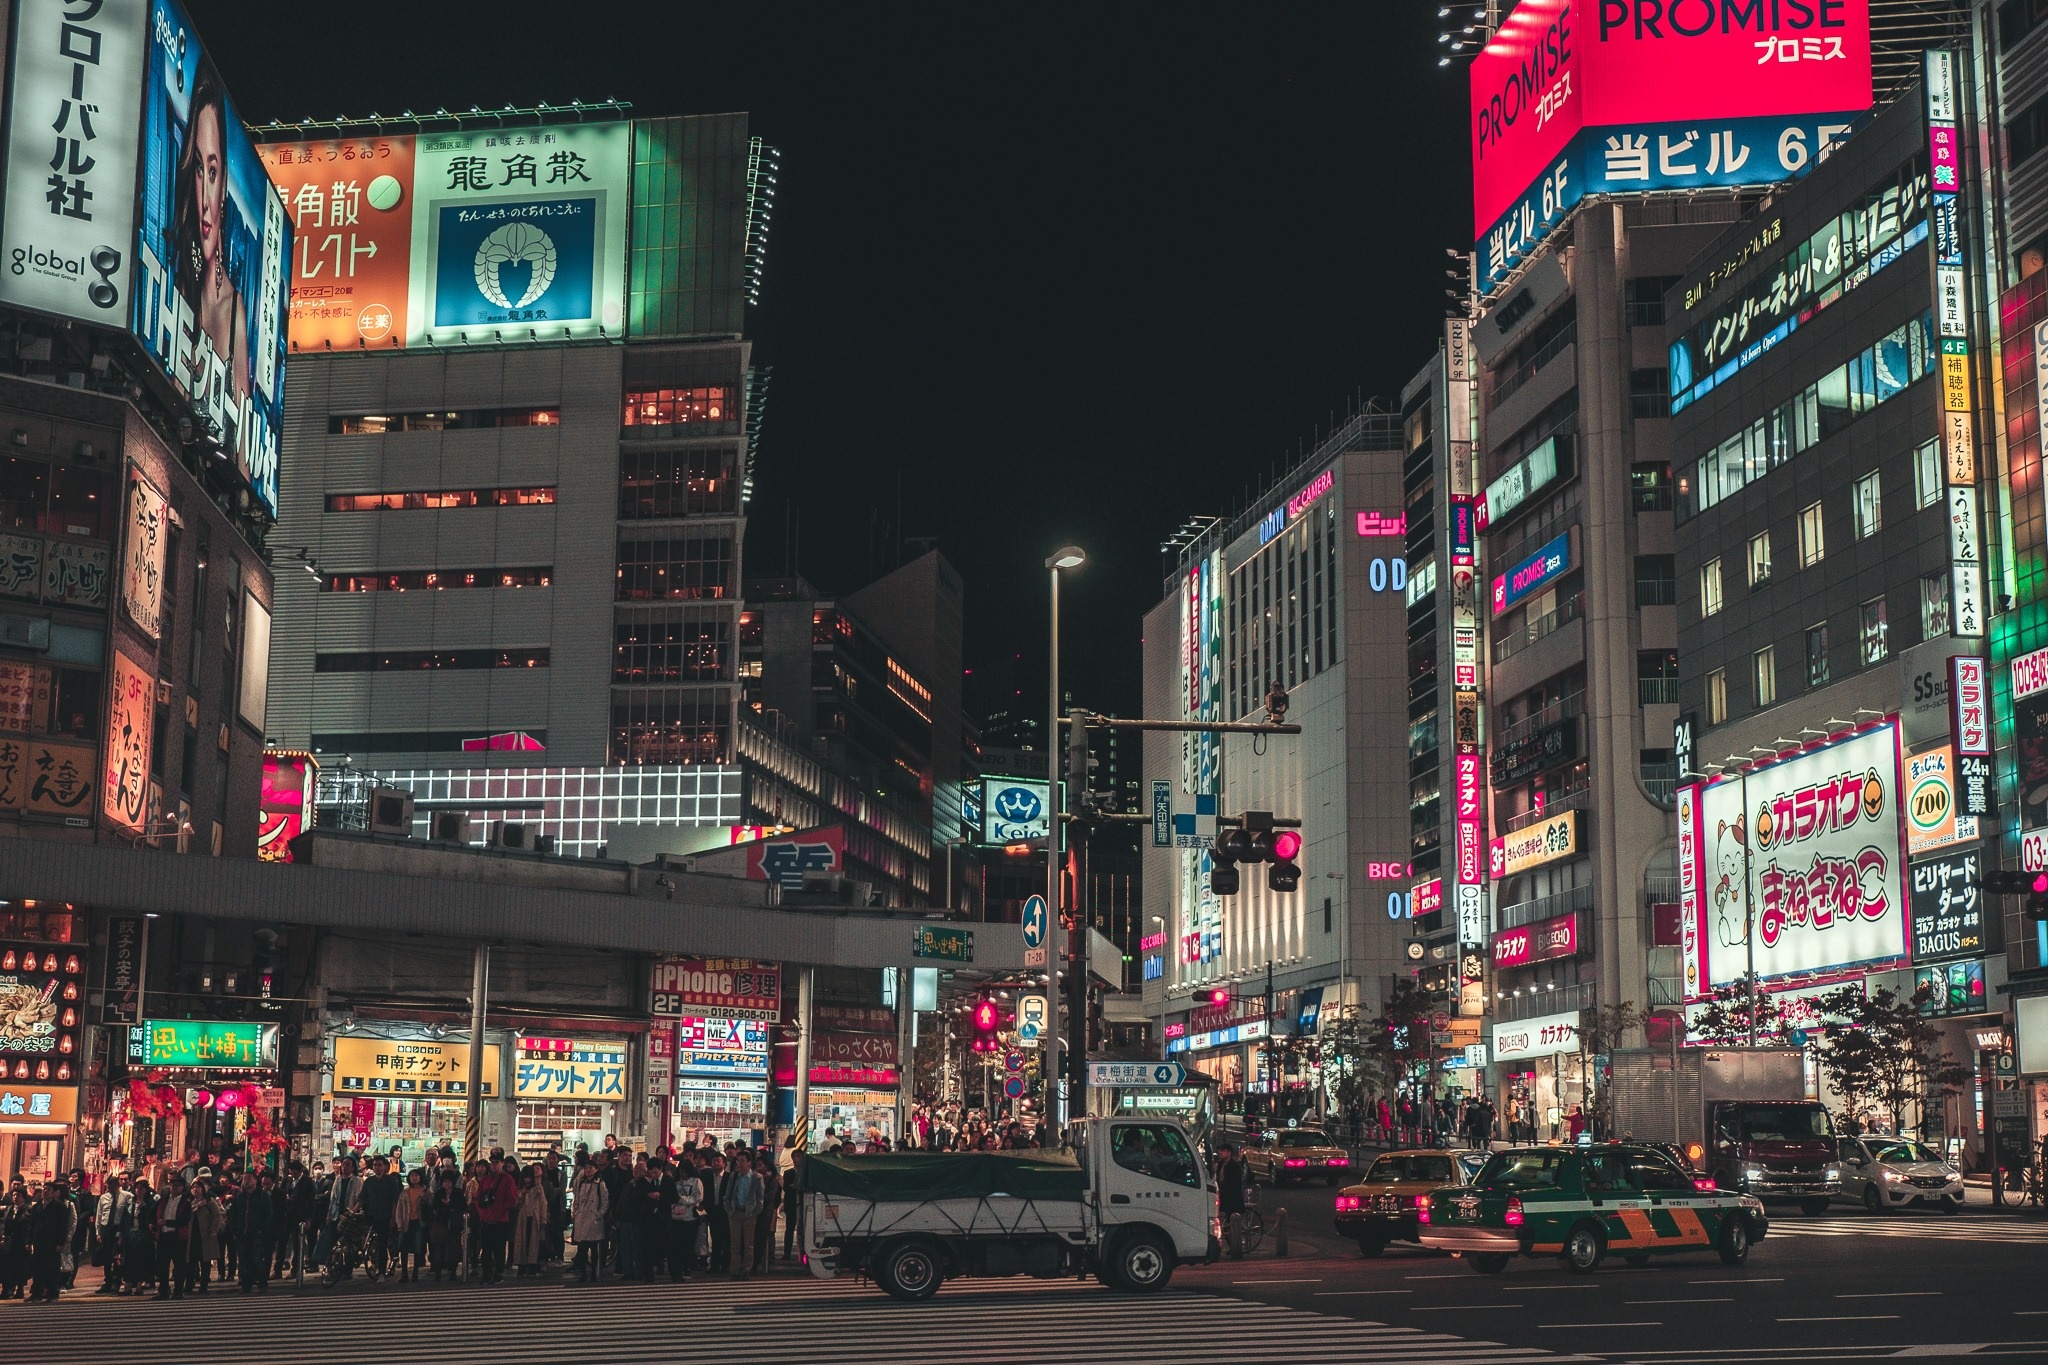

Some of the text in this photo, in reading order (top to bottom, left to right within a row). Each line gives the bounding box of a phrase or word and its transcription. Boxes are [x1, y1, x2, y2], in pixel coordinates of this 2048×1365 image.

[1600, 0, 1846, 43] PROMISE
[1754, 36, 1847, 65] プロミス
[1479, 6, 1571, 161] PROMISE
[1534, 70, 1573, 133] プロミス
[485, 133, 556, 148] 鎮咳去痰剤
[1604, 129, 1751, 181] 当ビル
[446, 150, 593, 192] 龍角散
[1489, 200, 1535, 277] 当ビル
[1542, 159, 1567, 221] 6F
[12, 245, 85, 276] global
[302, 288, 332, 297] マンゴー
[360, 313, 390, 329] 生薬
[1942, 322, 1965, 333] 歯科
[1944, 341, 1965, 353] 4F
[1948, 357, 1965, 409] 補聴器
[1953, 417, 1967, 480] とりえもん
[1289, 470, 1333, 519] BIC CAMERA
[1260, 505, 1285, 545] ODAKYU
[1357, 510, 1406, 536] ビッ
[1458, 507, 1467, 544] PROMISE
[1477, 503, 1486, 523] 7F
[1512, 556, 1546, 594] PROMISE
[1495, 586, 1504, 603] 6F
[129, 674, 142, 701] 3F
[1914, 671, 1933, 703] SS
[1960, 662, 1984, 747] カラオケ
[1462, 744, 1473, 753] 3F
[1, 742, 20, 806] おでん
[1961, 758, 1989, 776] 24H
[1461, 758, 1477, 816] カラオケ
[1967, 776, 1987, 813] 営業
[1773, 774, 1865, 848] カラオケ
[1915, 790, 1946, 817] ZOO
[1157, 803, 1168, 844] 矢印整理
[1176, 836, 1215, 849] 時差式
[1461, 822, 1475, 881] BIG ECHO
[1368, 862, 1402, 878] BIC
[1491, 846, 1504, 873] 3F
[1914, 856, 1976, 893] ビリヤード
[1681, 830, 1697, 955] カラオケ
[1760, 845, 1890, 948] まねきねこ
[1938, 886, 1977, 916] ダーツ
[1463, 899, 1471, 941] ルノアール
[1916, 912, 1979, 935] ゴルフ カラオケ 卓球
[1495, 935, 1527, 960] カラオケ
[1551, 927, 1570, 945] ECHO
[1919, 931, 1961, 955] BAGUS
[654, 994, 680, 1012] 2F
[711, 1007, 777, 1020] 0120-905-019
[130, 1027, 143, 1057] 新宿
[153, 1027, 255, 1062] 思い出横丁
[574, 1042, 625, 1053] Money Exchange
[1499, 1033, 1529, 1052] BIG ECHO
[1540, 1023, 1573, 1045] カラオケ
[376, 1054, 460, 1072] 甲南チケット
[1096, 1065, 1148, 1077] 青梅街道
[1159, 1069, 1168, 1080] 4
[517, 1063, 585, 1094] チケット
[588, 1067, 624, 1095] オズ
